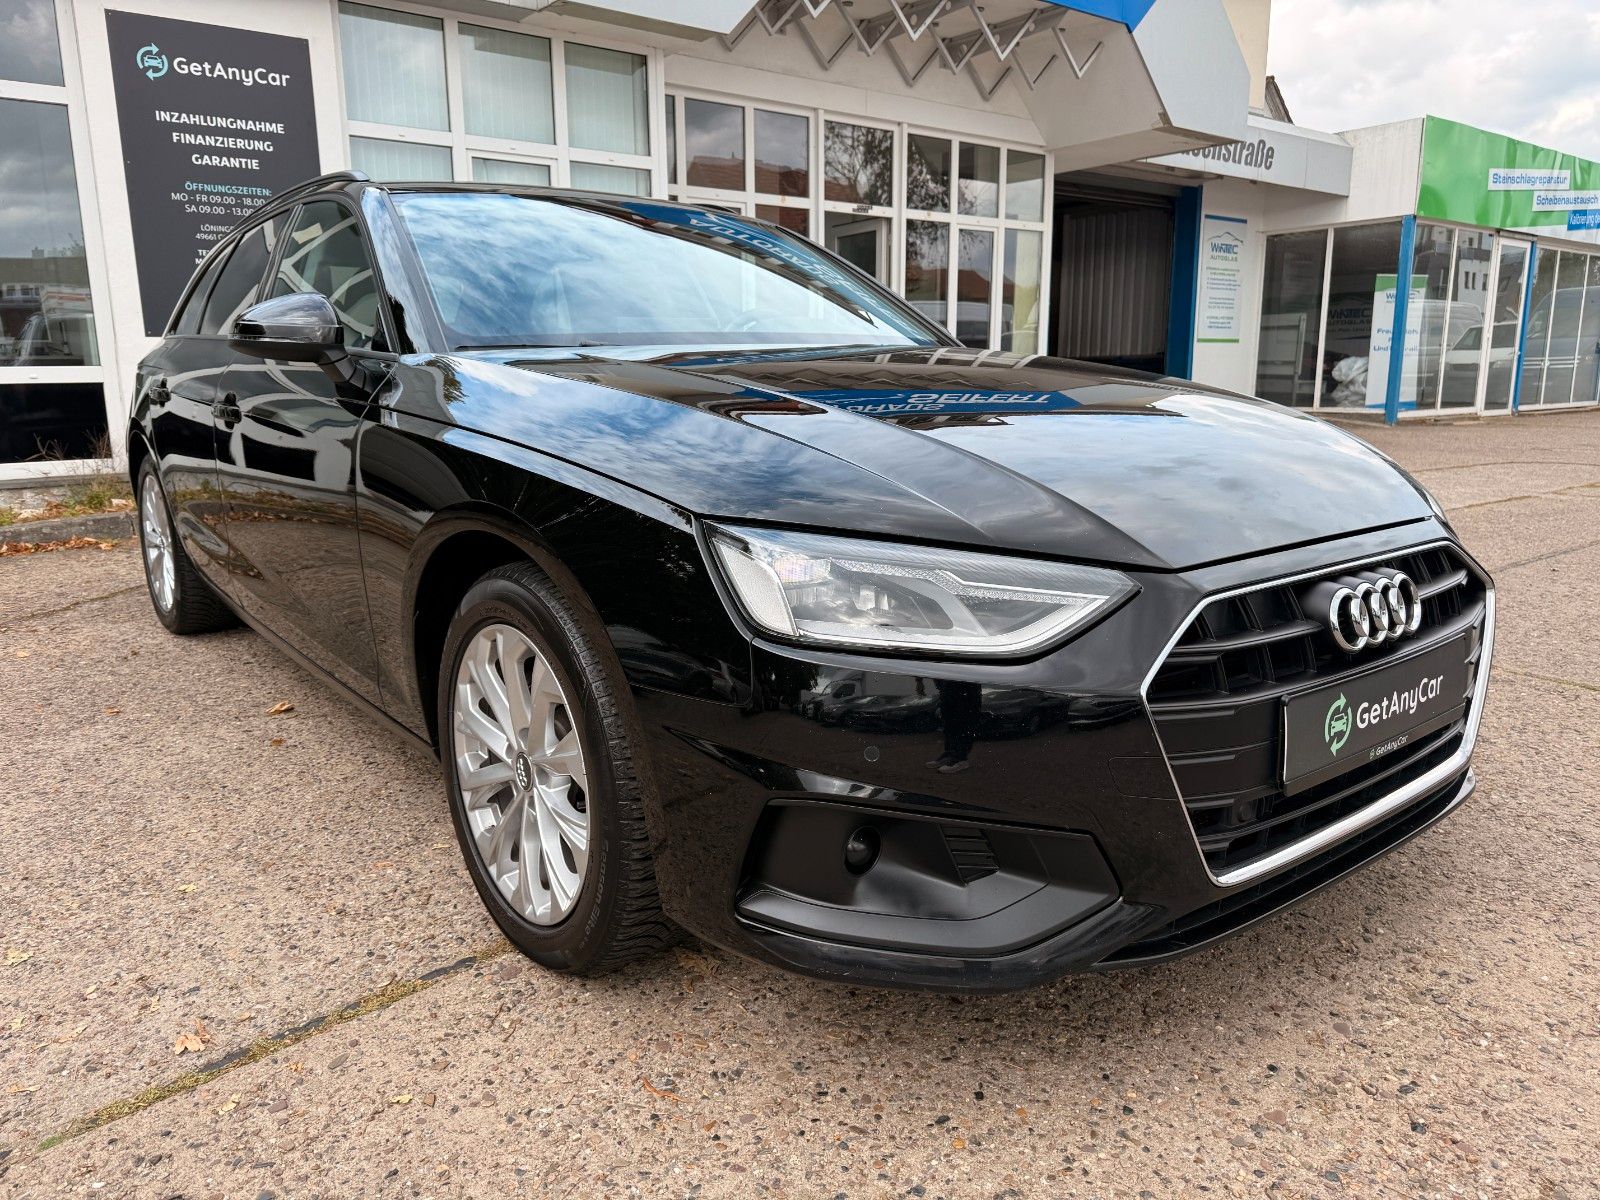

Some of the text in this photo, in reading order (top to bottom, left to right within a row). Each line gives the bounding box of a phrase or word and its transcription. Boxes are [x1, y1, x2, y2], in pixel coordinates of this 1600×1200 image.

[173, 57, 290, 87] GetAnyCar
[155, 110, 285, 134] INZAHLUNGNAHME
[172, 132, 274, 152] FINANZIERUNG
[191, 153, 260, 170] GARANTIE
[1492, 173, 1567, 186] Steinschlagreparatur
[184, 181, 272, 197] ÖFFNUNGSZEITEN:
[171, 192, 189, 202] MO
[196, 194, 208, 203] FR
[209, 196, 235, 205] 09.00
[1536, 195, 1599, 207] Scheibenaustausch
[184, 204, 197, 213] SA
[199, 205, 225, 215] 09.00
[1356, 674, 1444, 729] GetAnyCar
[1375, 735, 1409, 757] GetAnyCar
